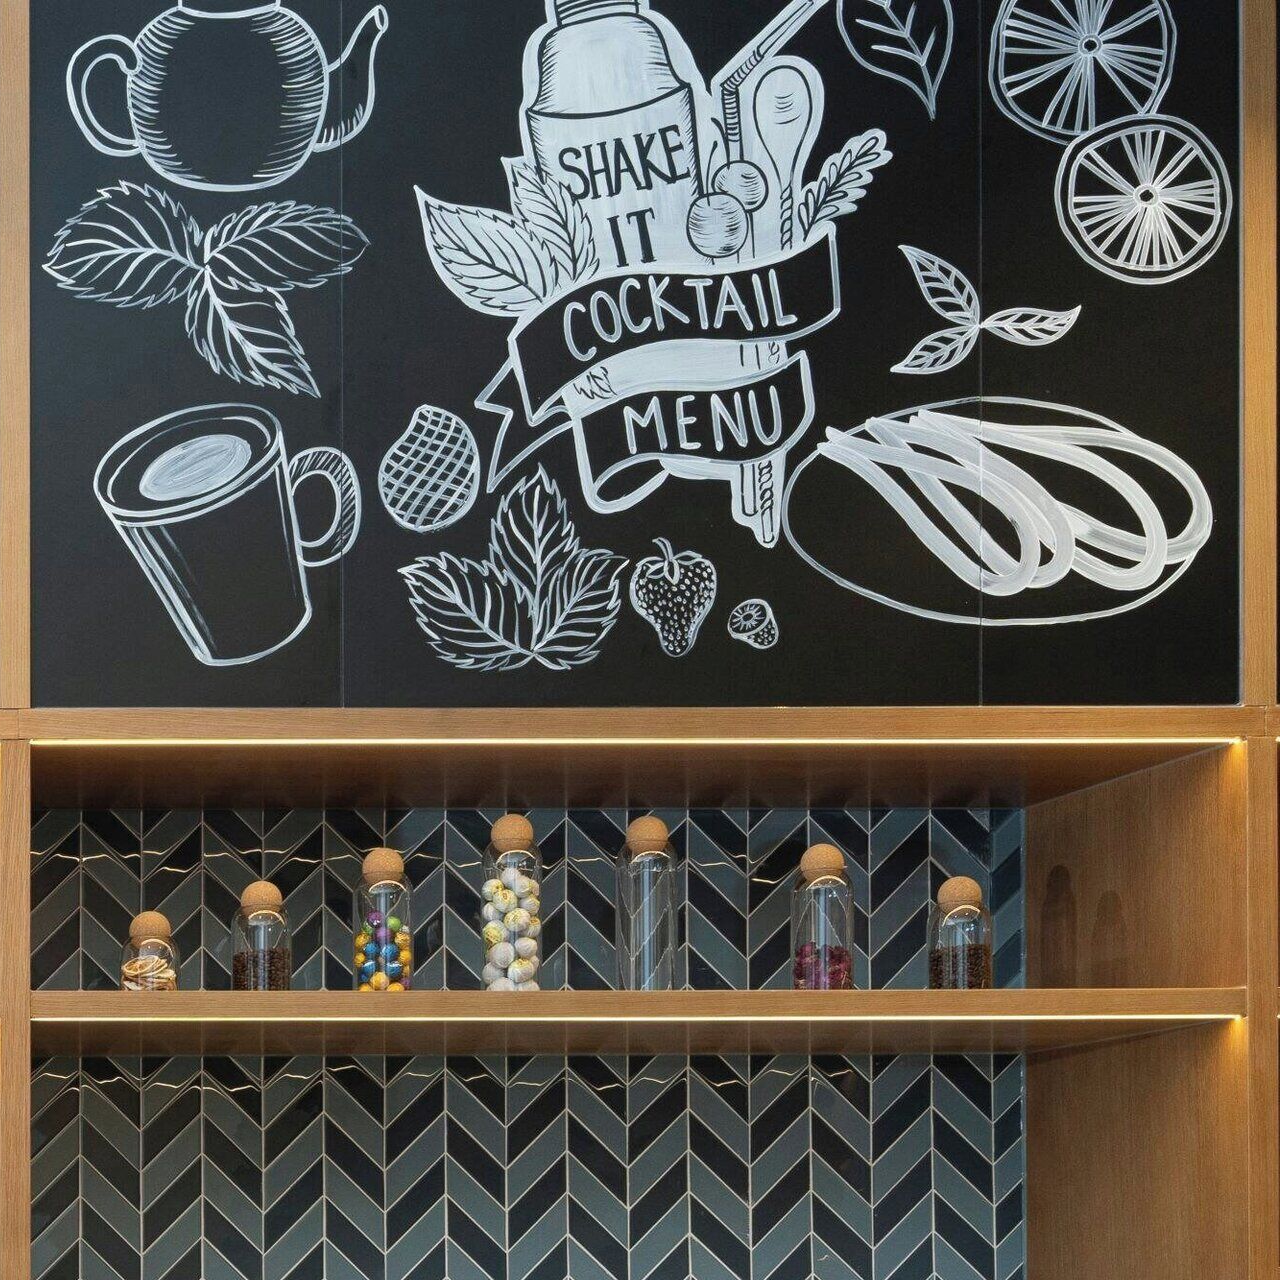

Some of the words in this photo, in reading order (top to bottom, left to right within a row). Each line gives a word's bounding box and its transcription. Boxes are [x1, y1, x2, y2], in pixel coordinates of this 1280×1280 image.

[558, 124, 693, 200] SHAKE
[607, 207, 657, 268] IT
[563, 269, 798, 362] COCKTAIL
[623, 386, 782, 454] MENU
